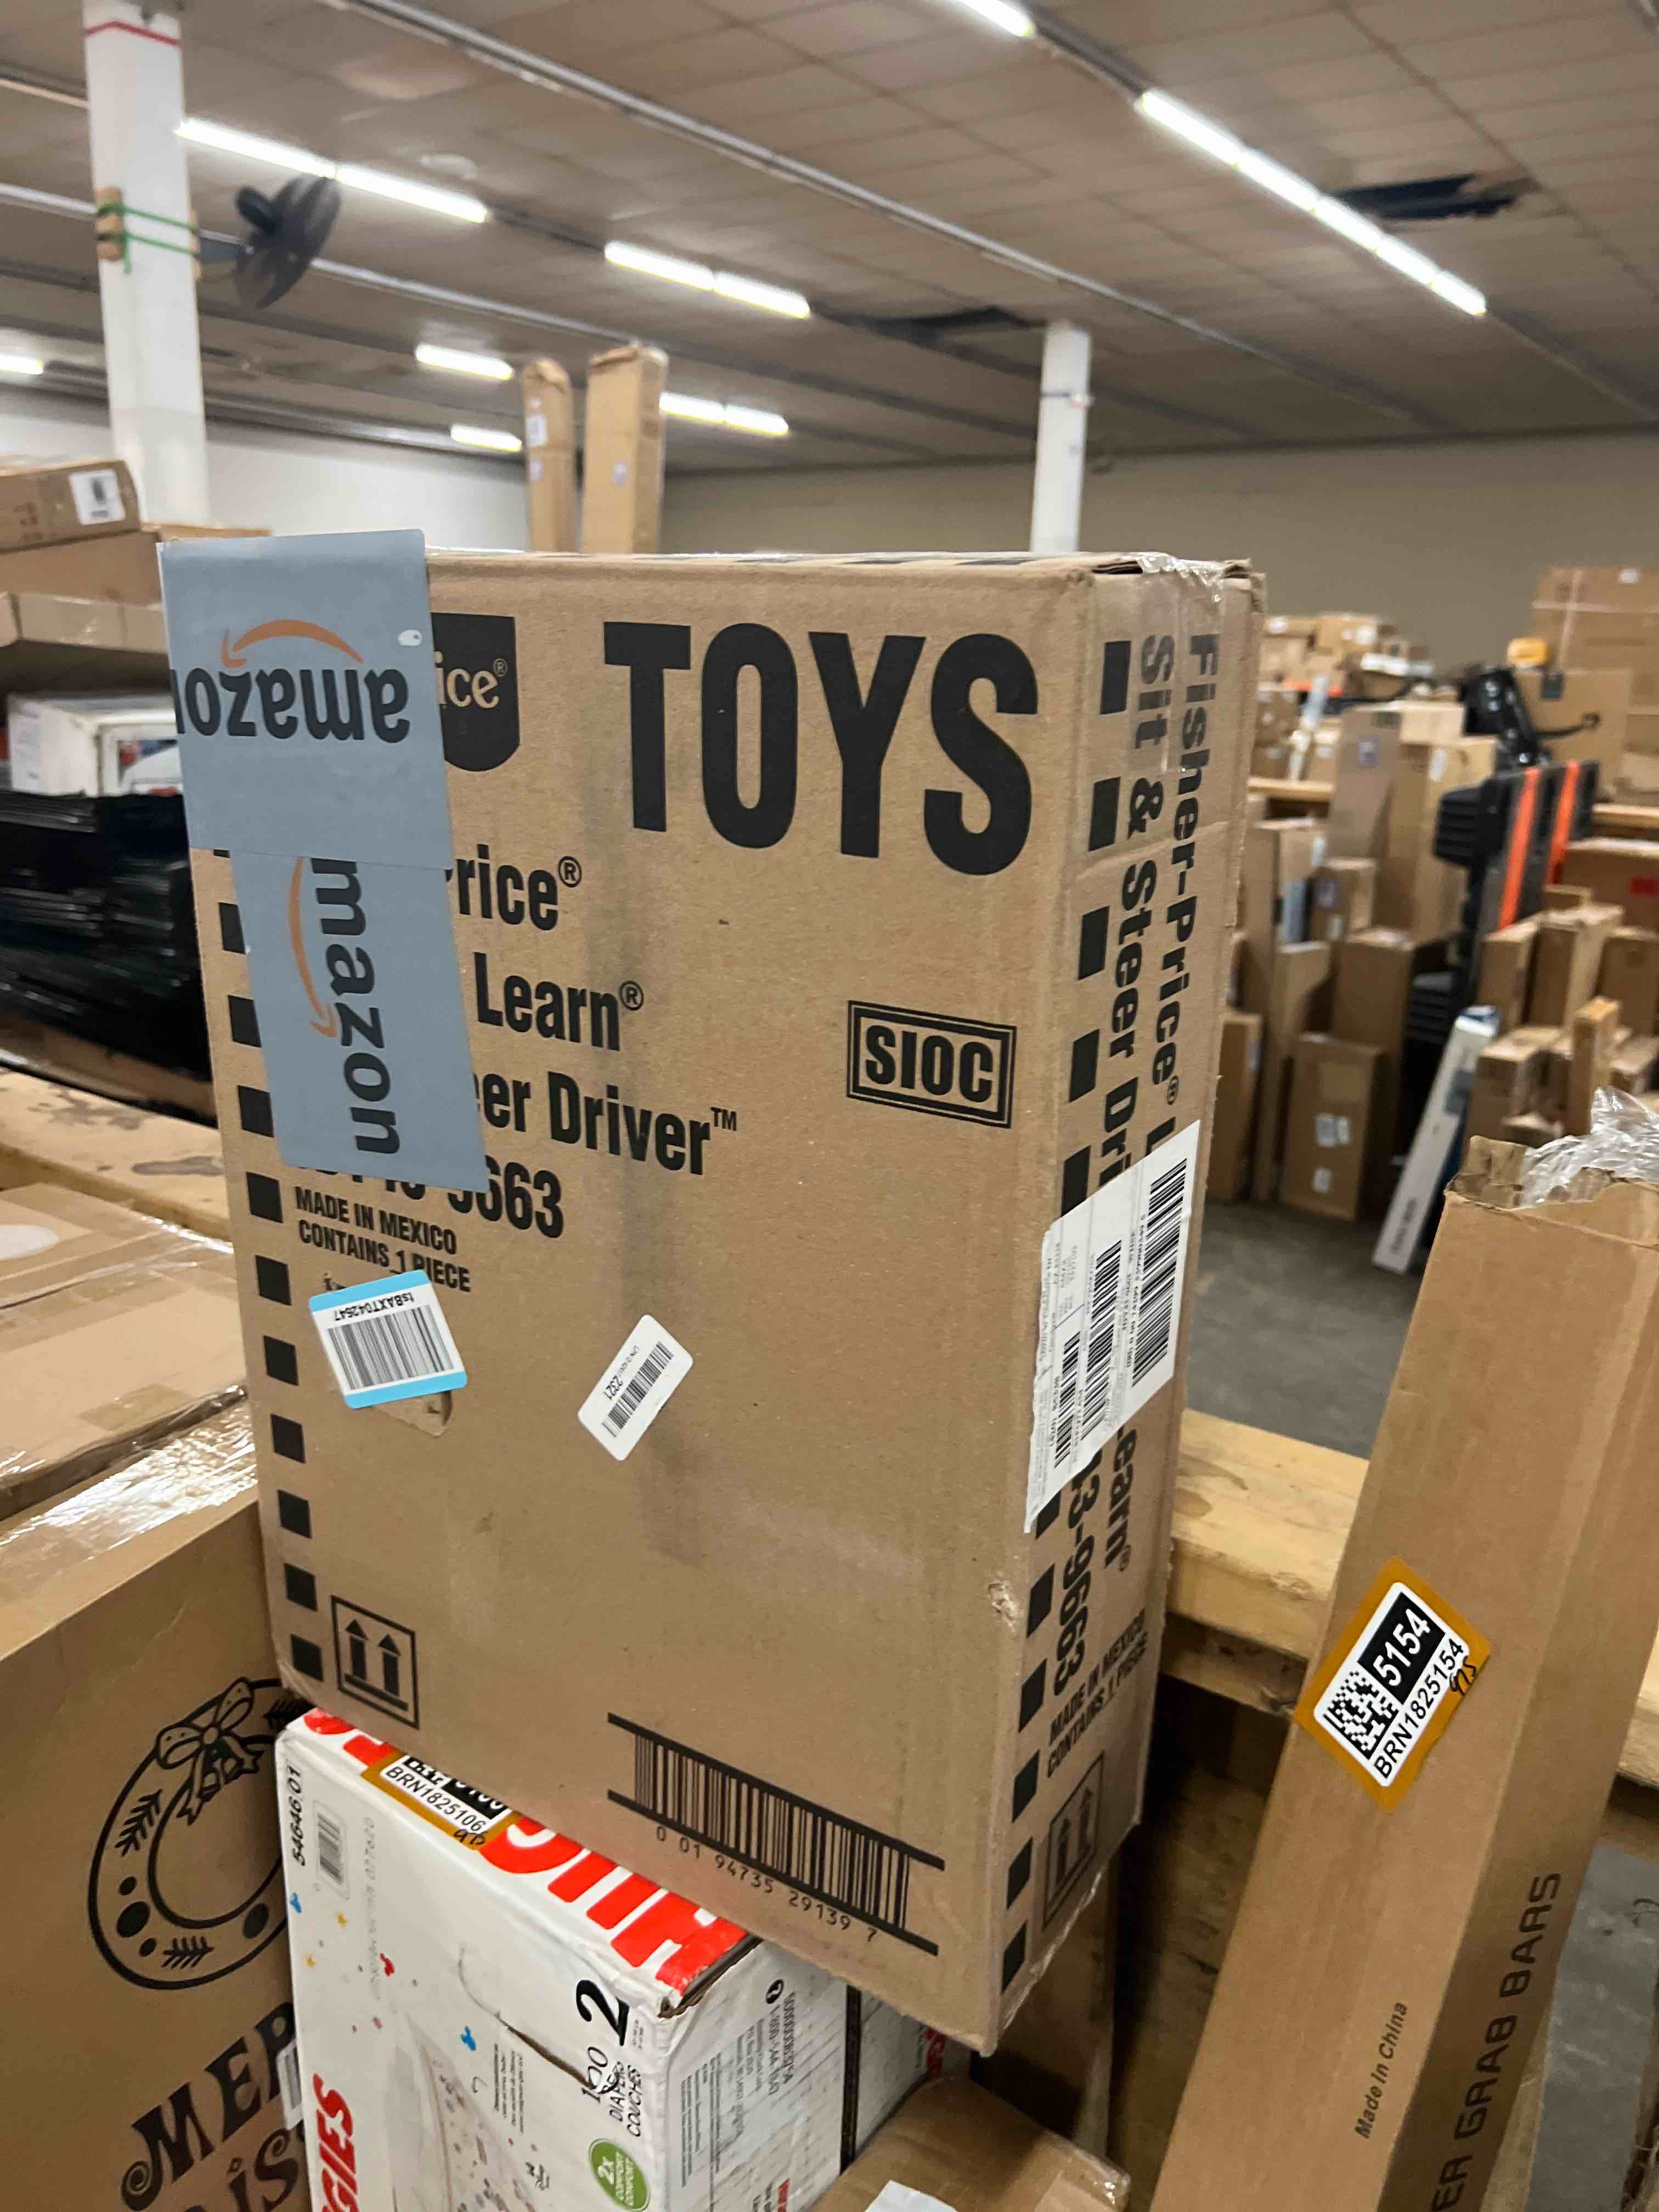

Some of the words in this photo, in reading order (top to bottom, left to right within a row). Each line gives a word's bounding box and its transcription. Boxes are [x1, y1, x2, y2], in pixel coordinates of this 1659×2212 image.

[1135, 635, 1175, 749] Sit
[603, 622, 1039, 876] TOYS
[1127, 778, 1163, 840] &
[1109, 860, 1157, 1058] Steer
[311, 857, 399, 1154] mazon
[865, 1025, 994, 1102] SIOC
[1099, 1077, 1138, 1187] Dri
[294, 1186, 349, 1223] MADE
[354, 1203, 374, 1231] IN
[378, 1210, 457, 1254] MEXICO
[298, 1220, 390, 1267] CONTAINS
[394, 1250, 406, 1274] 1
[411, 1252, 471, 1293] PIECE
[1373, 1608, 1431, 1686] 5154
[1047, 1687, 1105, 1778] CONTAINS
[1049, 1682, 1086, 1747] MADE
[1087, 1663, 1099, 1697] IN
[1374, 1638, 1463, 1779] BRN1825154
[386, 1765, 487, 1832] BRN1825106
[657, 1826, 666, 1842] 0
[680, 1838, 701, 1859] 01
[715, 1854, 774, 1893] 94735
[788, 1891, 851, 1931] 29139
[867, 1928, 877, 1942] 7
[576, 1979, 630, 2046] 2
[1454, 2015, 1517, 2141] GRAB
[1499, 1874, 1561, 1997] BARS
[627, 2064, 641, 2137] COUCHES
[1355, 2086, 1383, 2138] Made
[1379, 2002, 1408, 2059] China
